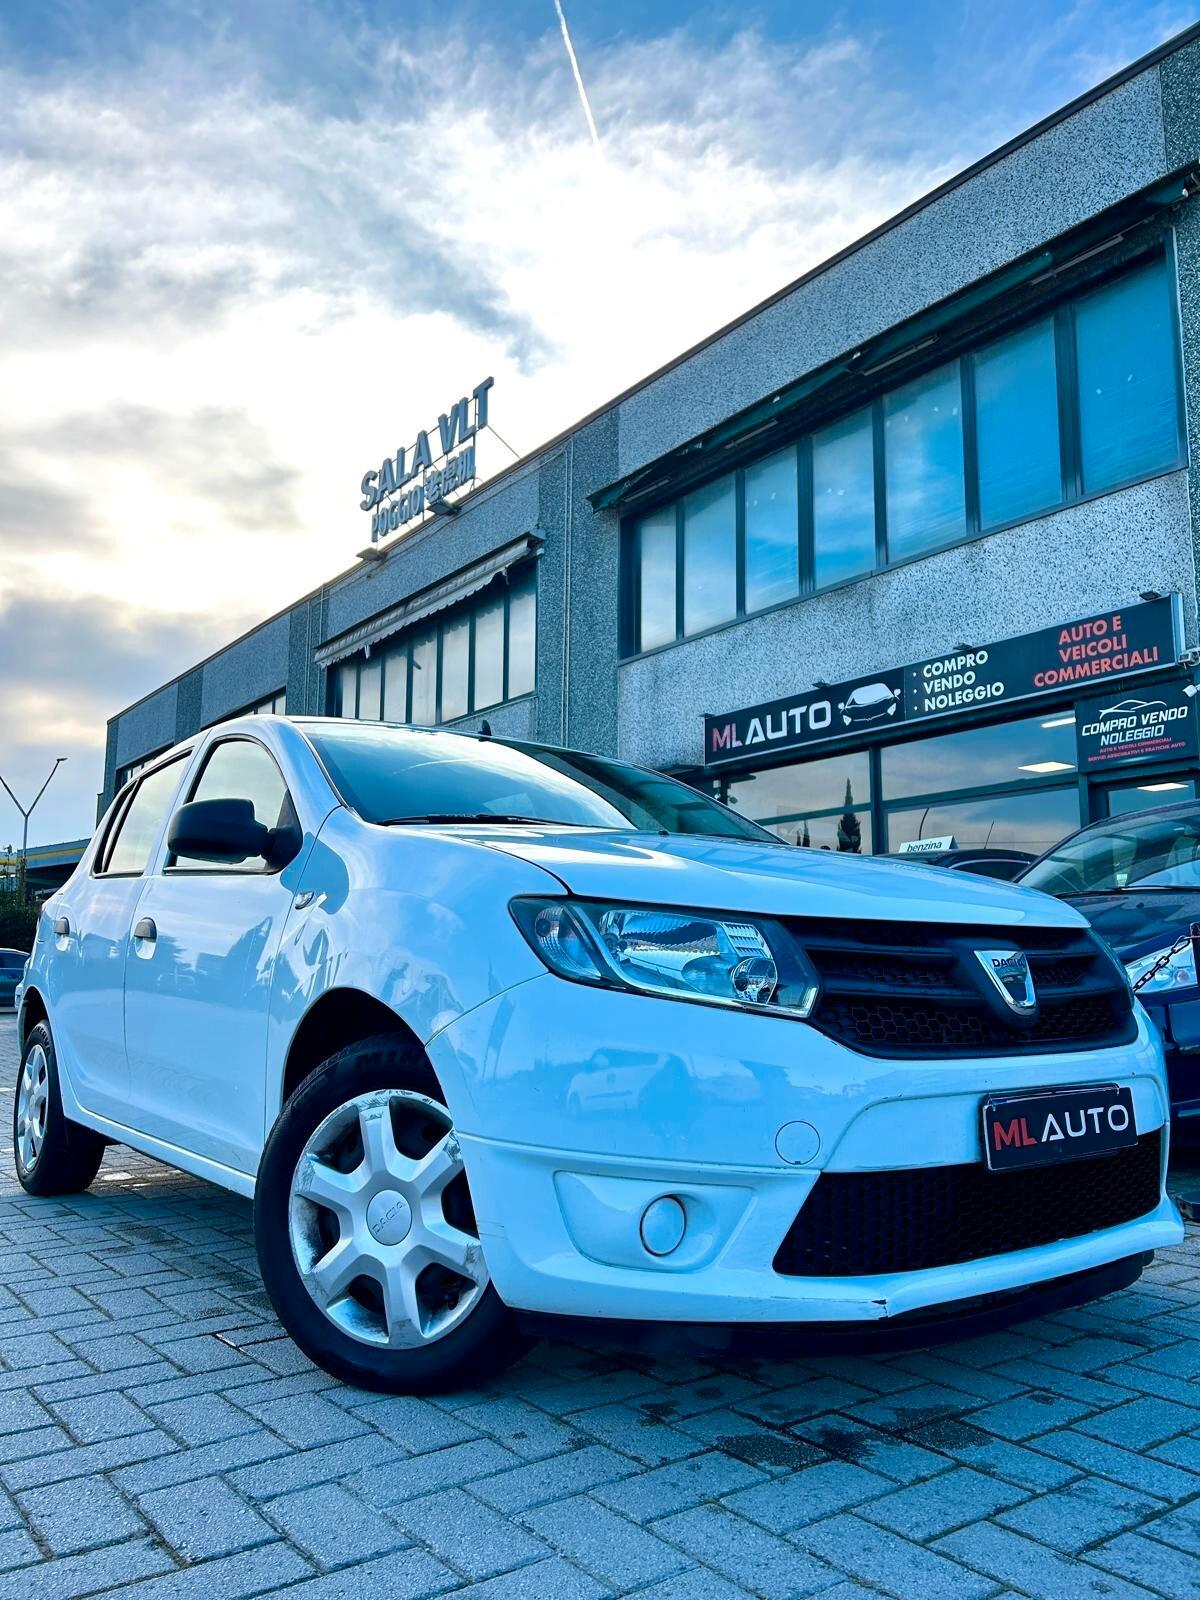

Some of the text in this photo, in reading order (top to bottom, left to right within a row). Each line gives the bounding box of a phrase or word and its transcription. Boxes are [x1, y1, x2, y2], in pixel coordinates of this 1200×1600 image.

[360, 376, 494, 511] SALA VLT
[371, 485, 425, 543] POGGIO
[1058, 615, 1122, 645] AUTO E
[1058, 634, 1127, 663] VEICOLI
[923, 650, 989, 678] COMPRO
[1033, 646, 1159, 688] COMMERCIALI
[923, 671, 976, 695] VENDO
[924, 682, 1005, 712] NOLEGGIO
[712, 700, 832, 752] ML AUTO
[1081, 706, 1188, 737] COMPRO VENDO
[1100, 724, 1165, 746] NOLEGGIO
[907, 841, 943, 852] benzina
[991, 958, 1025, 968] DACIA
[993, 1104, 1130, 1150] ML AUTO
[372, 1201, 407, 1235] DACIA
